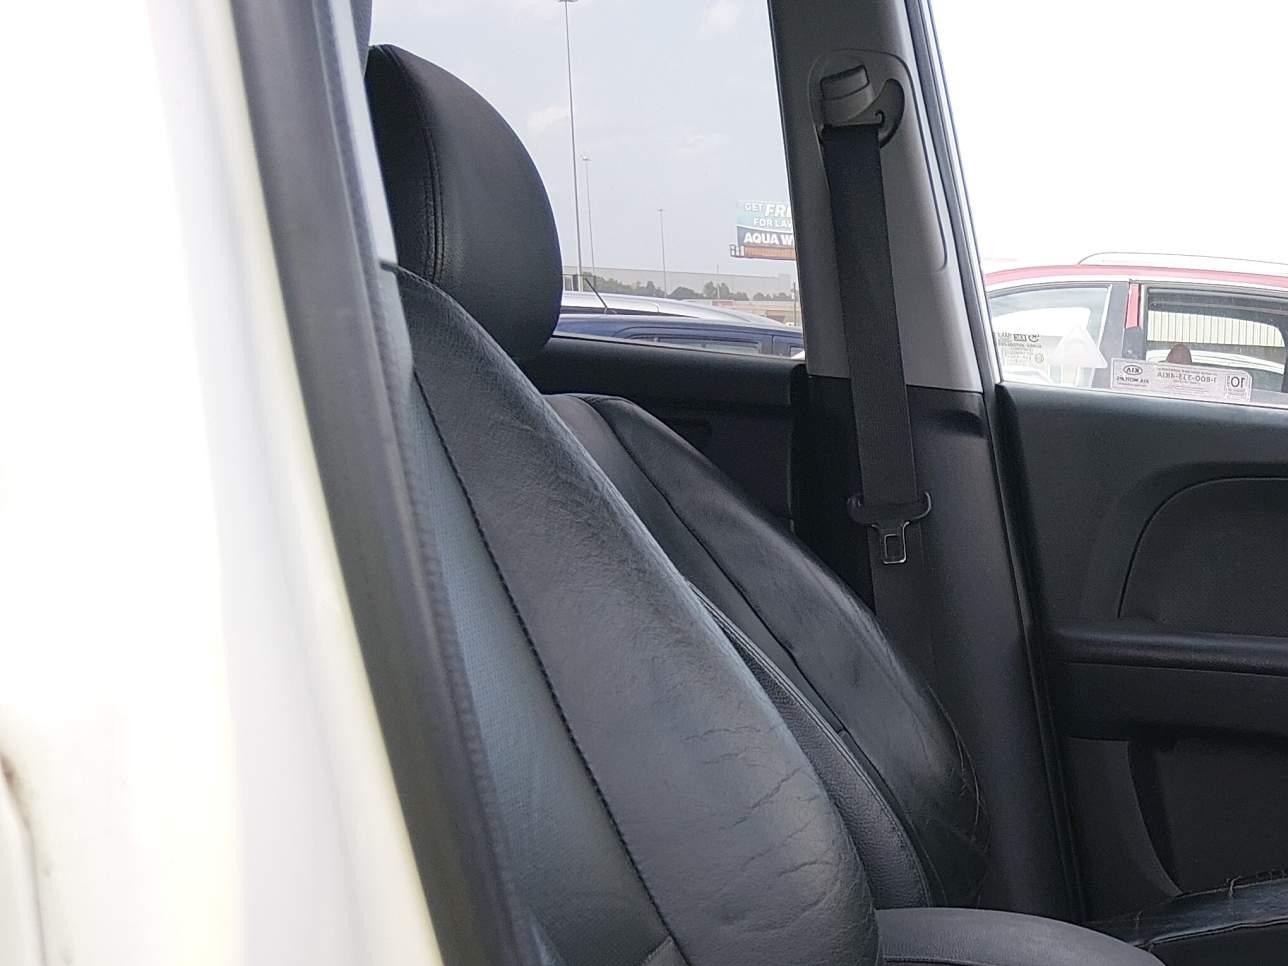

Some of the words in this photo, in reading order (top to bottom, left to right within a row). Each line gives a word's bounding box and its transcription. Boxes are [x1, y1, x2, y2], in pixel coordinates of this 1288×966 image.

[744, 202, 762, 211] GET
[753, 217, 772, 227] FOR
[743, 231, 779, 244] AQUA
